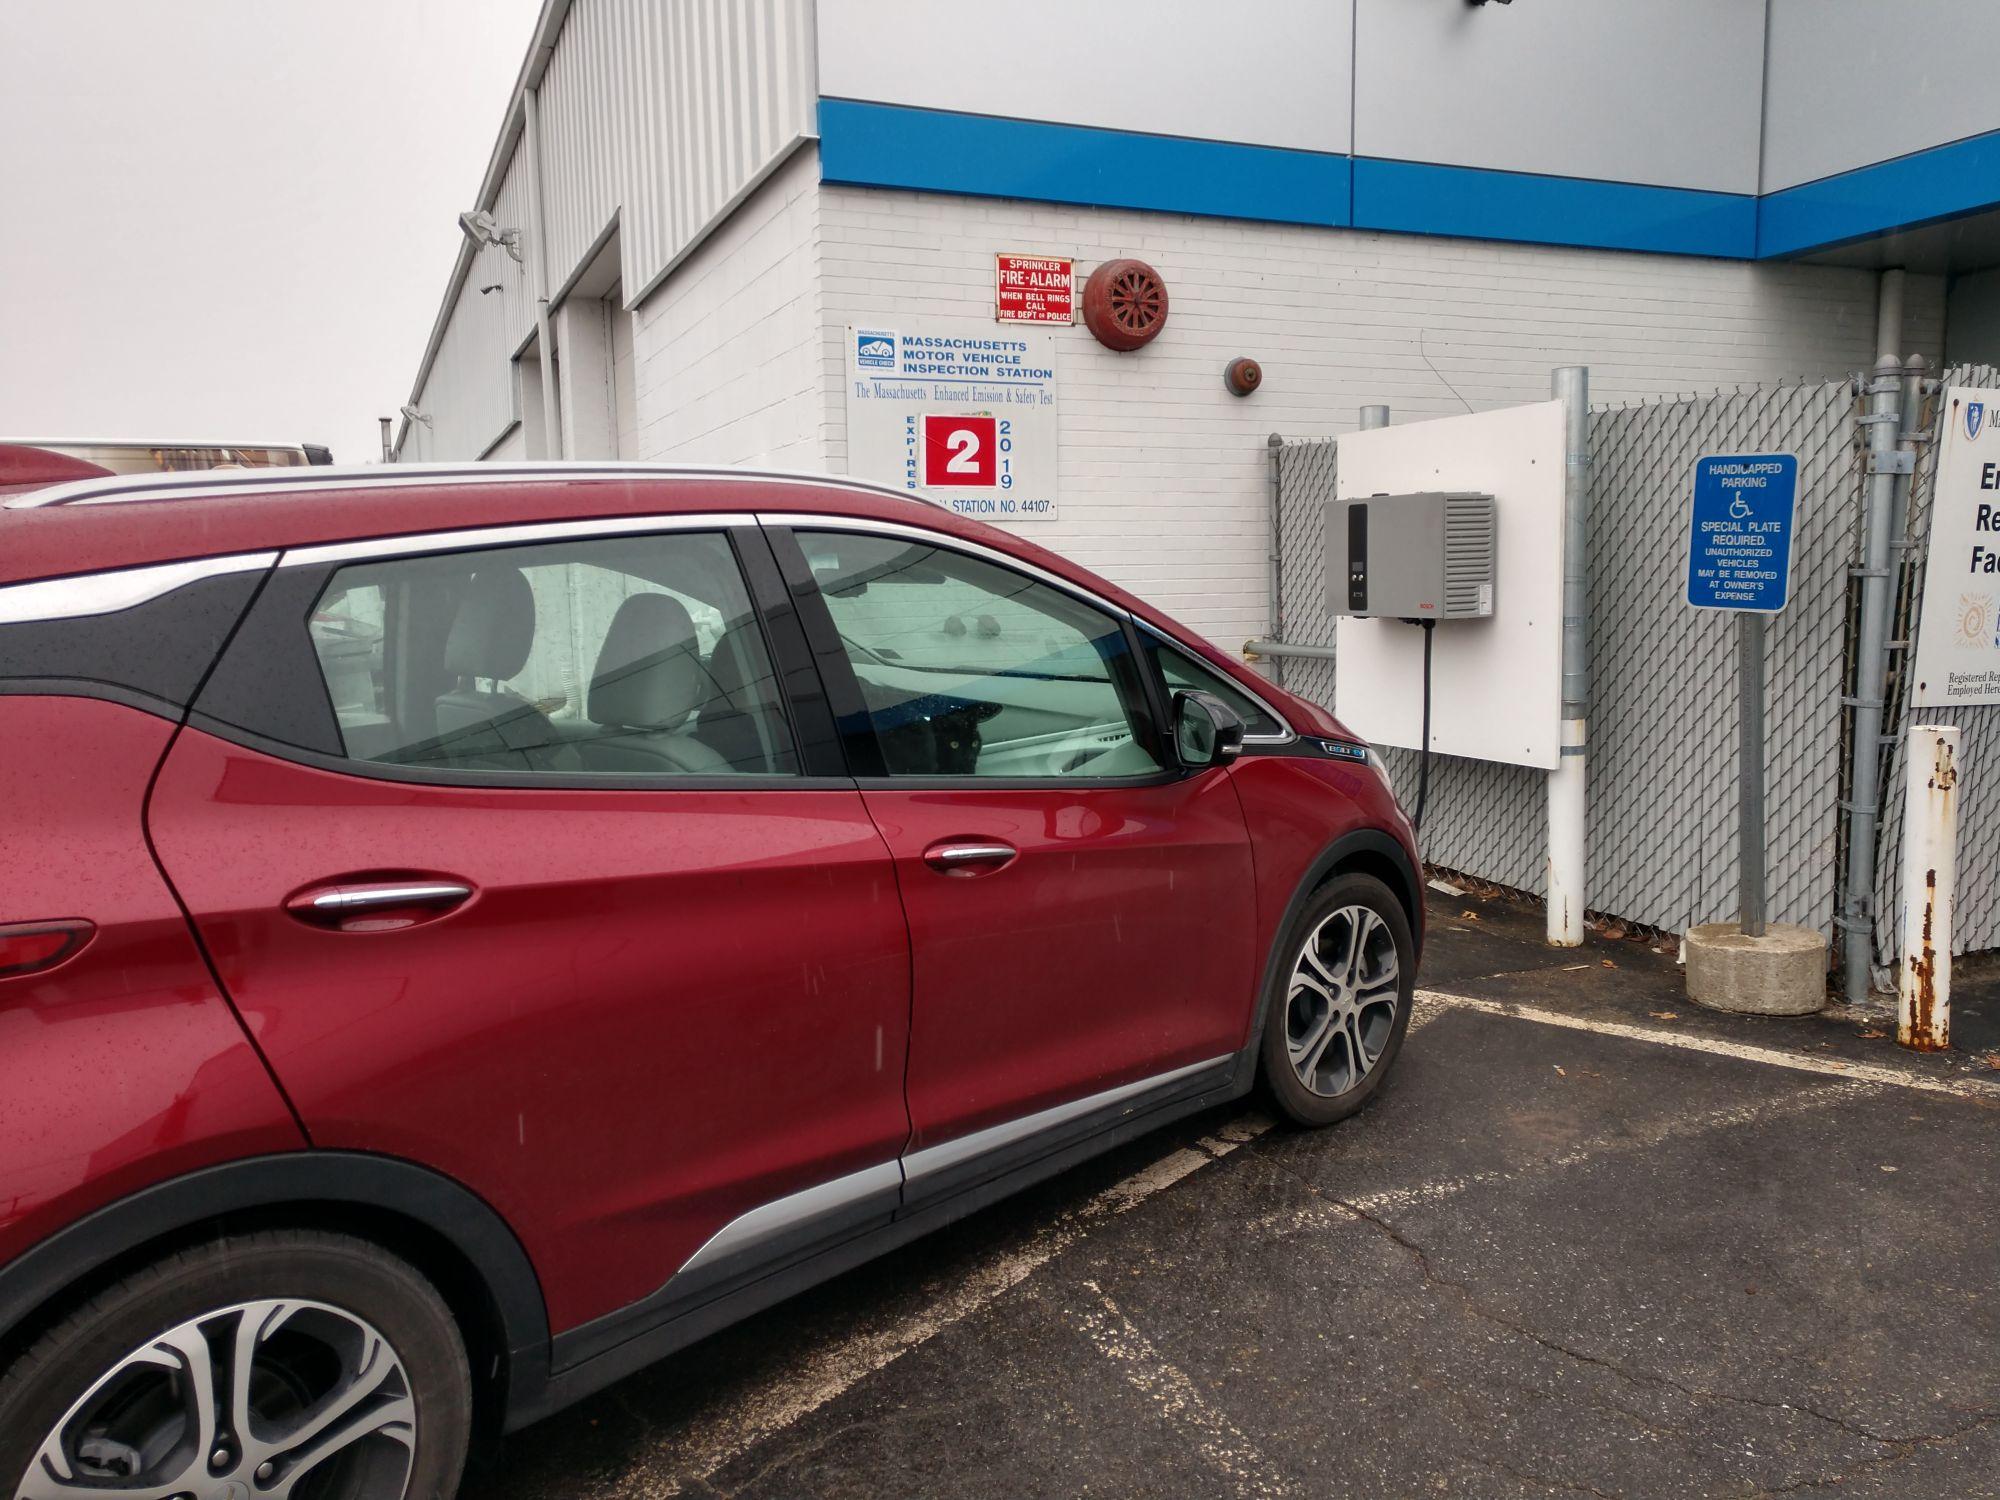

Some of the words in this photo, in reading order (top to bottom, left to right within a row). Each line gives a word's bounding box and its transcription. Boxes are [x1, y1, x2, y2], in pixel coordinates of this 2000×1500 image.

[1009, 260, 1061, 271] SPRINKLER
[1000, 270, 1070, 287] FIRE-ALARM
[1001, 292, 1023, 300] WHEN
[1026, 293, 1045, 301] BELL
[1047, 294, 1070, 303] RINGS
[1026, 302, 1046, 310] CALL
[1000, 310, 1016, 318] FIRE
[1047, 312, 1071, 320] POLICE
[902, 336, 1027, 352] MASSACHUSETTS
[903, 350, 955, 361] MOTOR
[963, 353, 1021, 364] VEHICLE
[903, 363, 989, 376] INSPECTION
[996, 367, 1053, 378] STATION
[855, 382, 870, 399] The
[874, 383, 927, 400] Massachusetts
[934, 384, 969, 402] Enhanced
[972, 386, 1003, 403] Emission
[1006, 388, 1012, 402] &
[1015, 388, 1037, 410] Safety
[1039, 389, 1053, 405] Test
[906, 416, 917, 489] EXPIRES
[946, 429, 980, 473] 2
[999, 420, 1013, 489] 2019
[1709, 463, 1782, 475] HANDICAPPED
[1721, 477, 1766, 488] PARKING
[952, 500, 995, 513] STATION
[1000, 500, 1018, 513] NO.
[1021, 500, 1050, 513] 44107
[1701, 521, 1744, 533] SPECIAL
[1748, 521, 1781, 533] PLATE
[1705, 548, 1773, 557] UNAUTHORIZED
[1717, 559, 1759, 568] VEHICLES
[1698, 569, 1715, 577] MAY
[1719, 570, 1731, 578] BE
[1734, 571, 1778, 579] REMOVED
[1709, 580, 1719, 589] AT
[1724, 581, 1765, 590] OWNER'S
[1948, 671, 1987, 686] Registered
[1947, 683, 1983, 698] Employed
